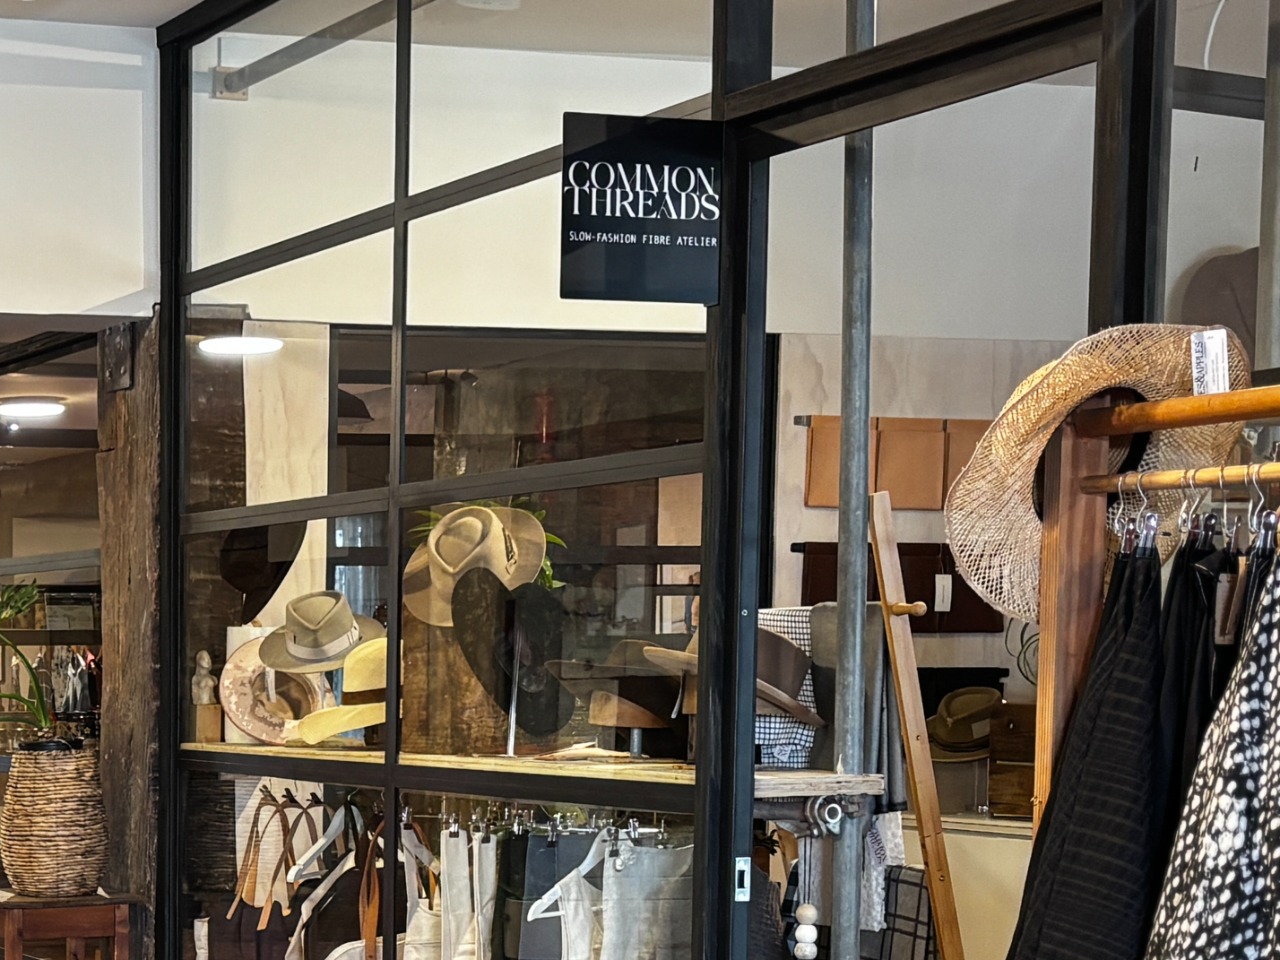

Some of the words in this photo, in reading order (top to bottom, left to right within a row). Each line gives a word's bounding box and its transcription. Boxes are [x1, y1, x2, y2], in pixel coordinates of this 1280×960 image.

[568, 160, 715, 196] COMMON
[563, 186, 720, 221] THREADS
[569, 231, 637, 244] SLOW-FASHION
[642, 234, 671, 245] FIBRE
[676, 236, 717, 247] ATELIER
